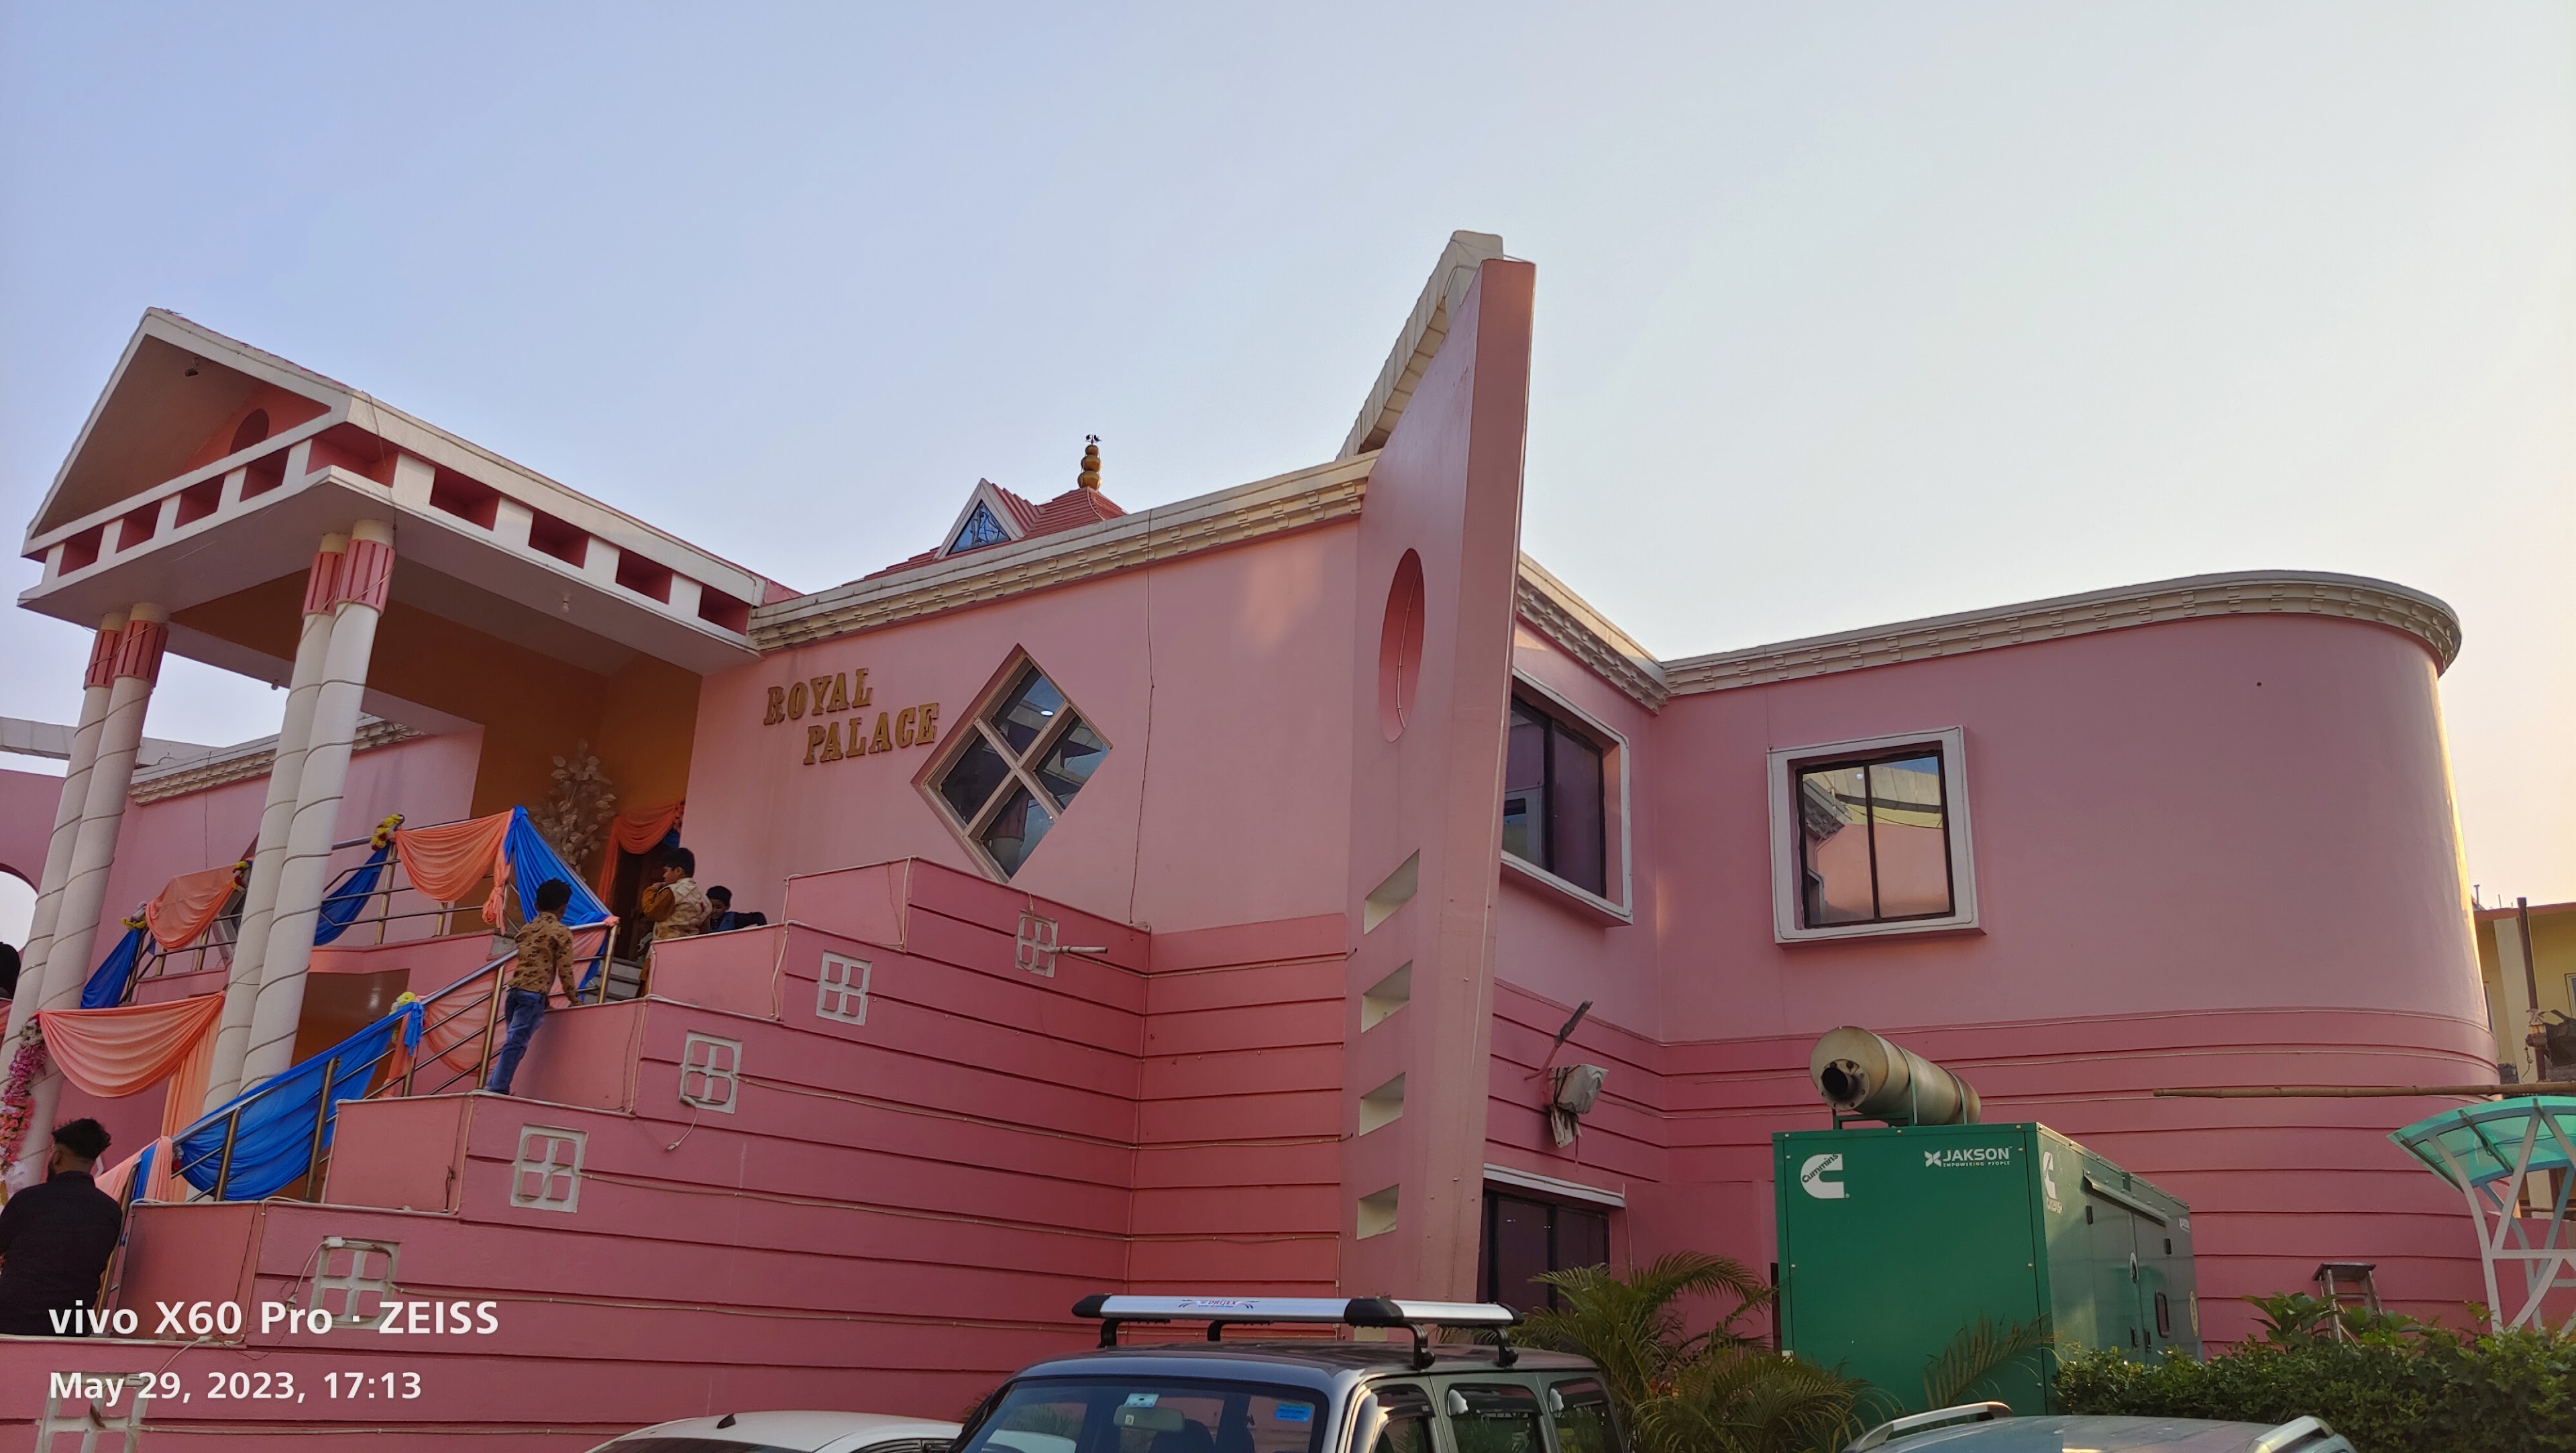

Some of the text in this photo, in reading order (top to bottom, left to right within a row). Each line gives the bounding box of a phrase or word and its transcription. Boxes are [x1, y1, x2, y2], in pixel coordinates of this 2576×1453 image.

[763, 667, 873, 725] ROYAL
[803, 702, 938, 765] PALACE
[1802, 1154, 1839, 1183] Cummins
[1943, 1148, 2010, 1162] JAKSON
